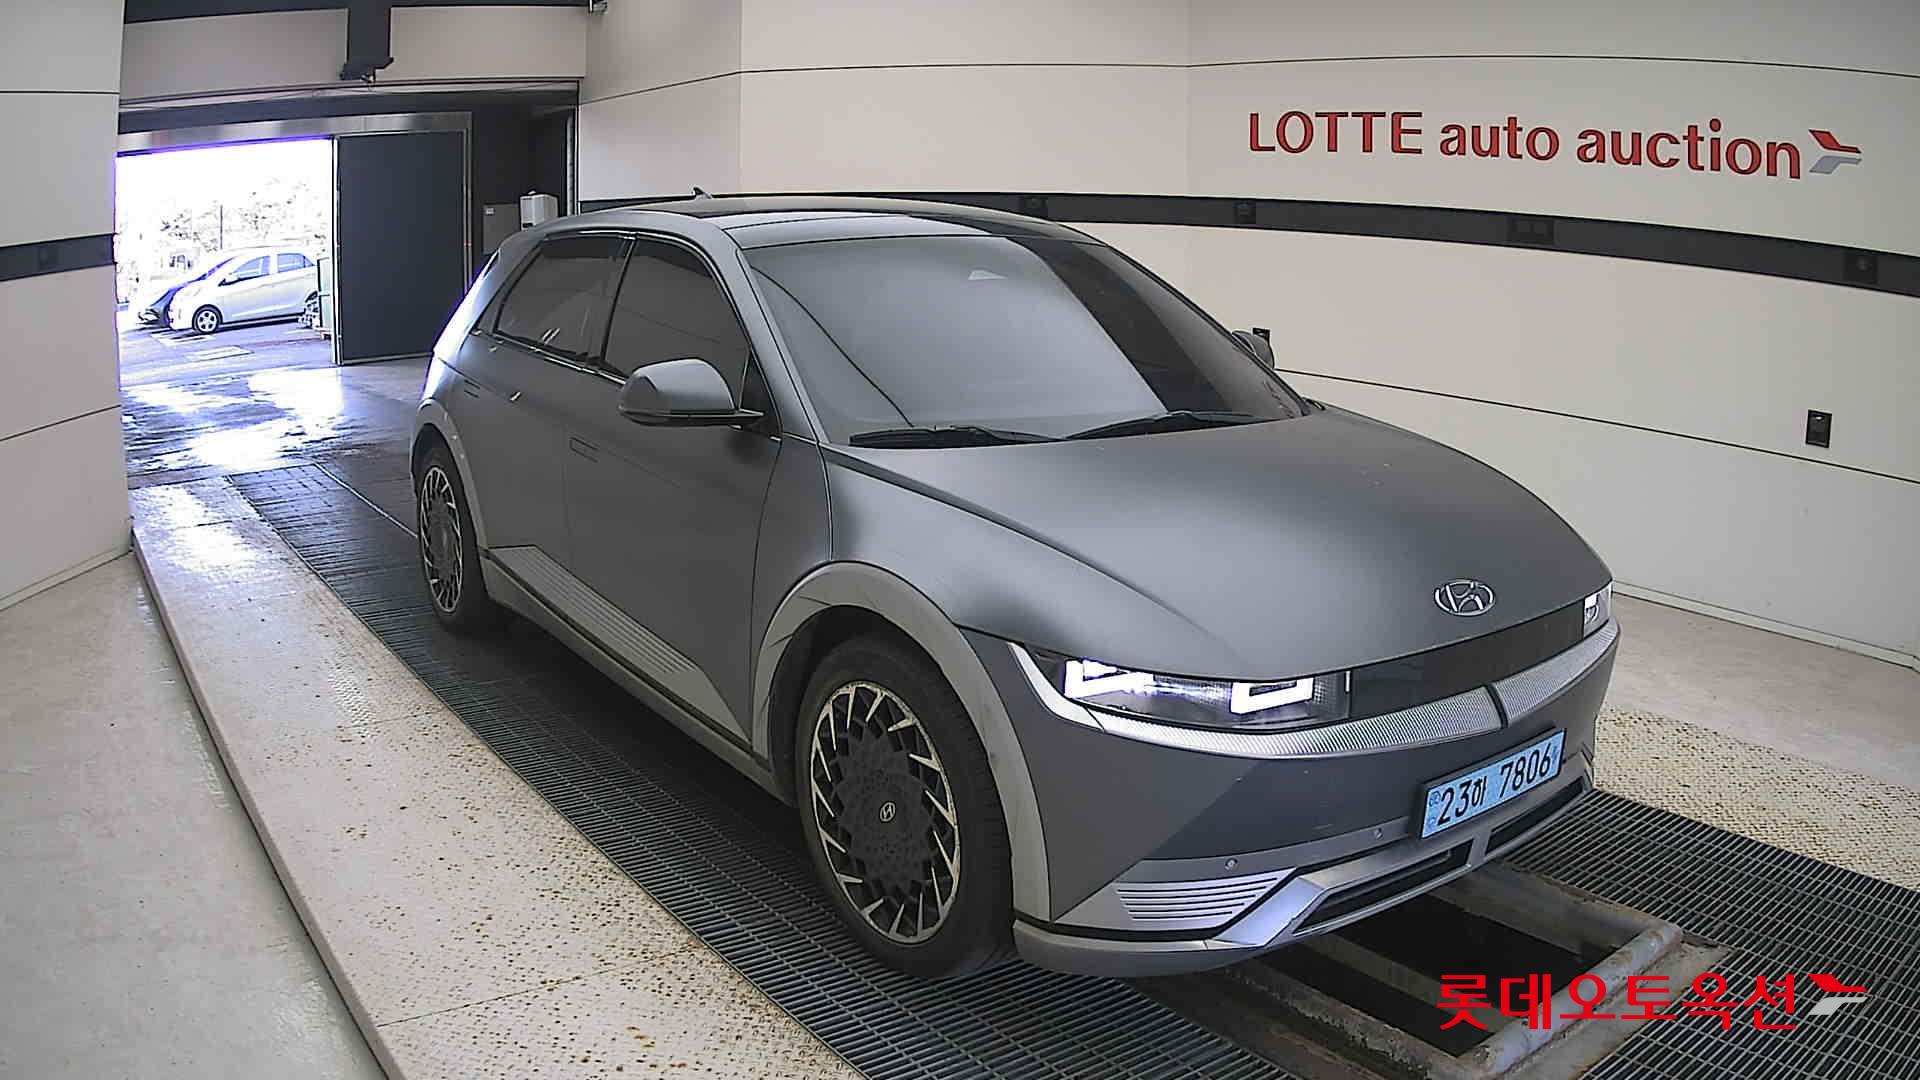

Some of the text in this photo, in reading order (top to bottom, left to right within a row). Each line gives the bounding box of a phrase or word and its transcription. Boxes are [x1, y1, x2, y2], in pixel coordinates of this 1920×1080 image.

[1248, 111, 1801, 179] LOTTE auto auction
[1437, 743, 1552, 827] 23하 7806
